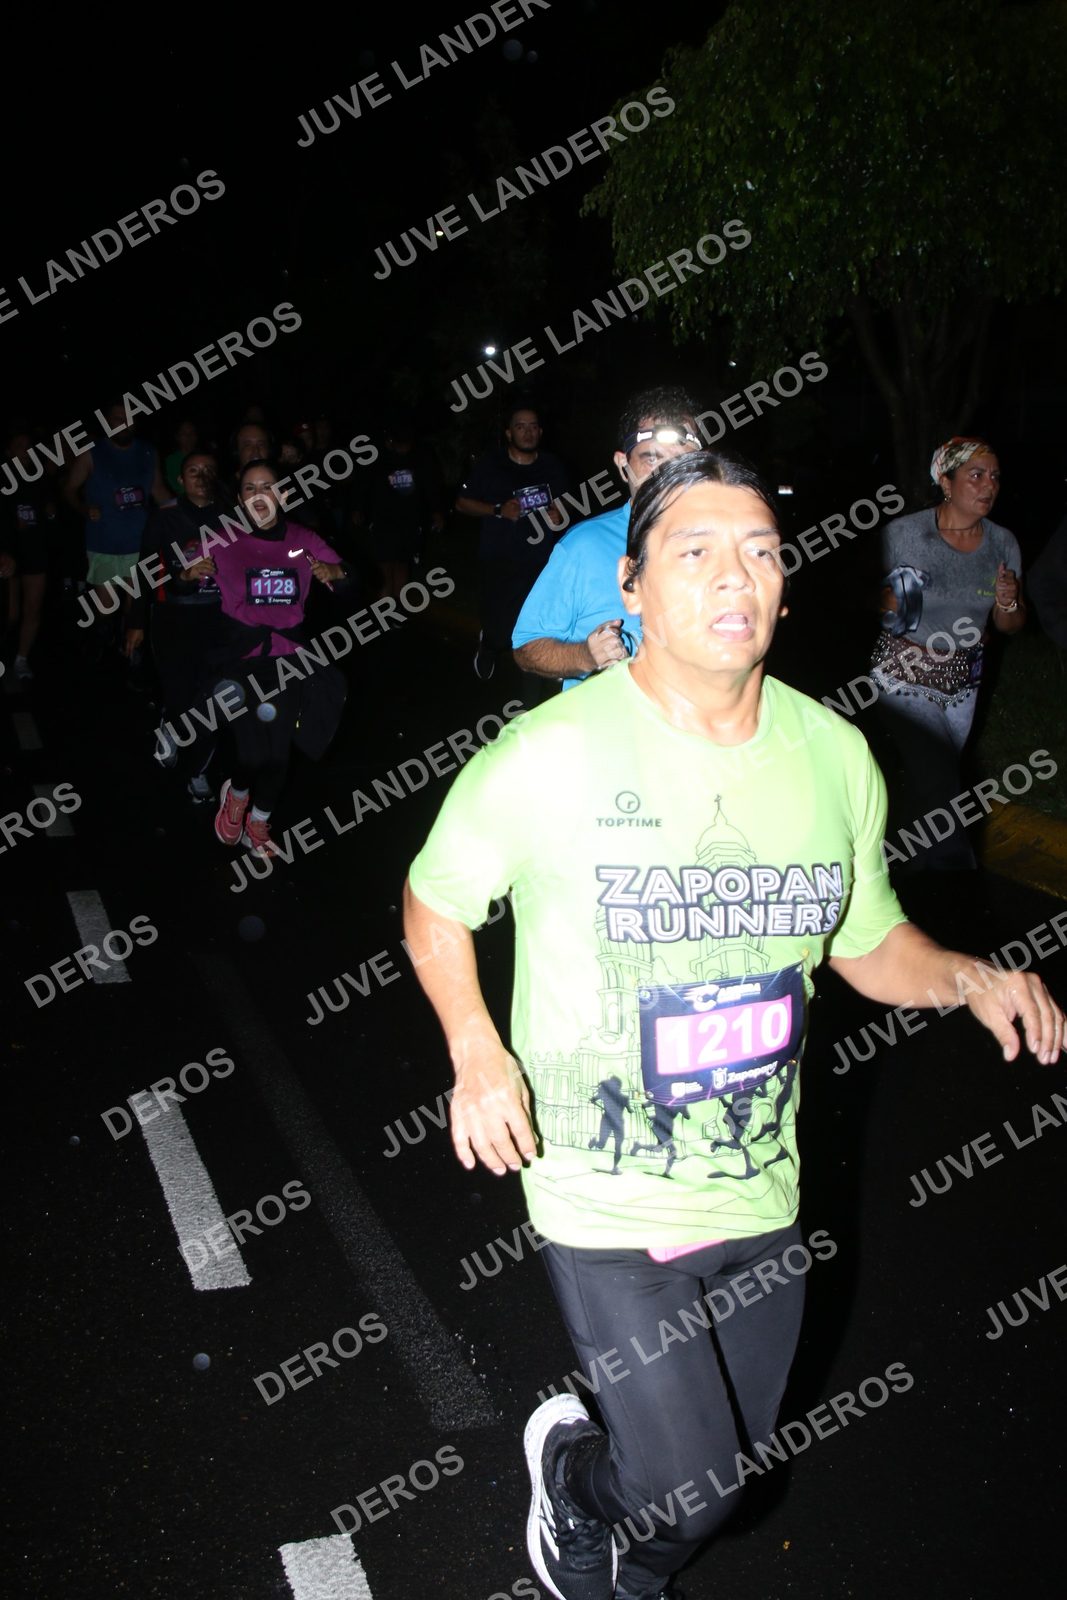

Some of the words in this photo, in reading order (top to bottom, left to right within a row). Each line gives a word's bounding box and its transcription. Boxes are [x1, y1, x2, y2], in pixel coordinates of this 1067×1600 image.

[521, 493, 548, 508] 1533
[254, 579, 294, 595] 1128
[596, 817, 663, 828] TOPTIME
[596, 862, 844, 905] ZAPOPAN
[605, 900, 841, 943] RUNNERS
[665, 1003, 788, 1068] 1210
